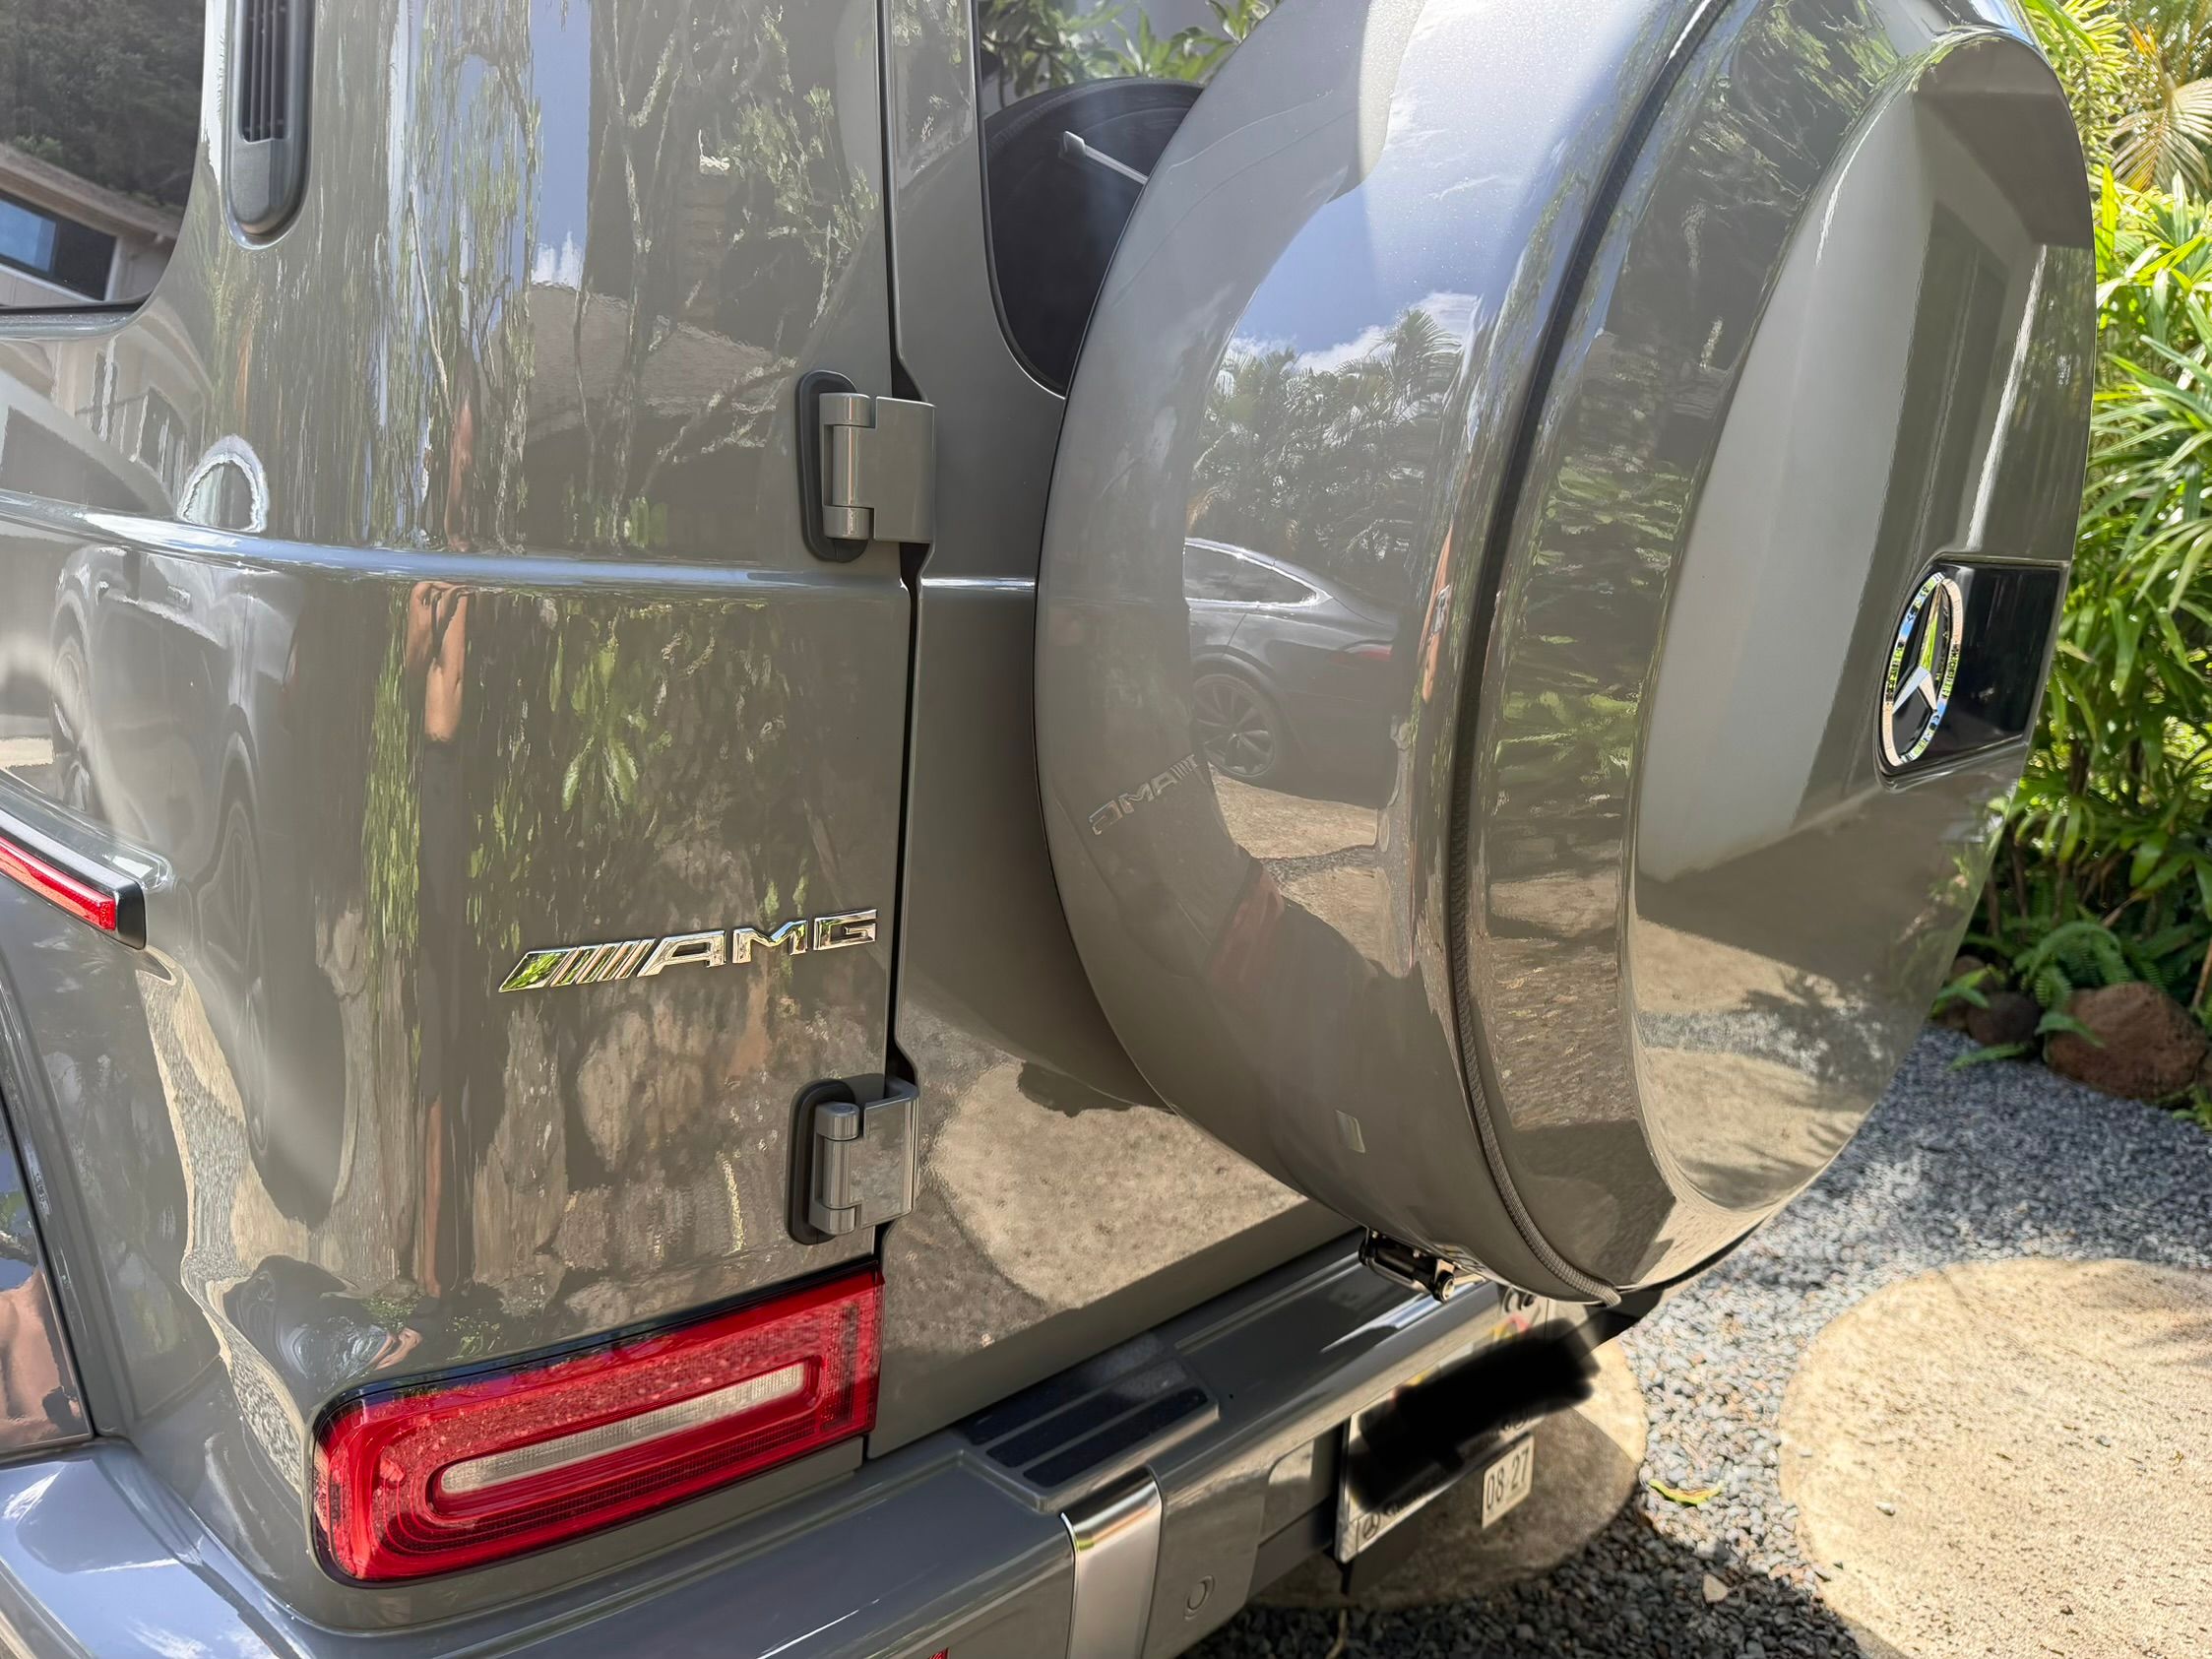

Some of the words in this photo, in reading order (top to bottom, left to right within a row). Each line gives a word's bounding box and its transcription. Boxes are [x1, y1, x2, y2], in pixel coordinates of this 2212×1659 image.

[636, 909, 878, 978] AMG
[1485, 1465, 1505, 1510] 08
[1511, 1447, 1530, 1491] 27
